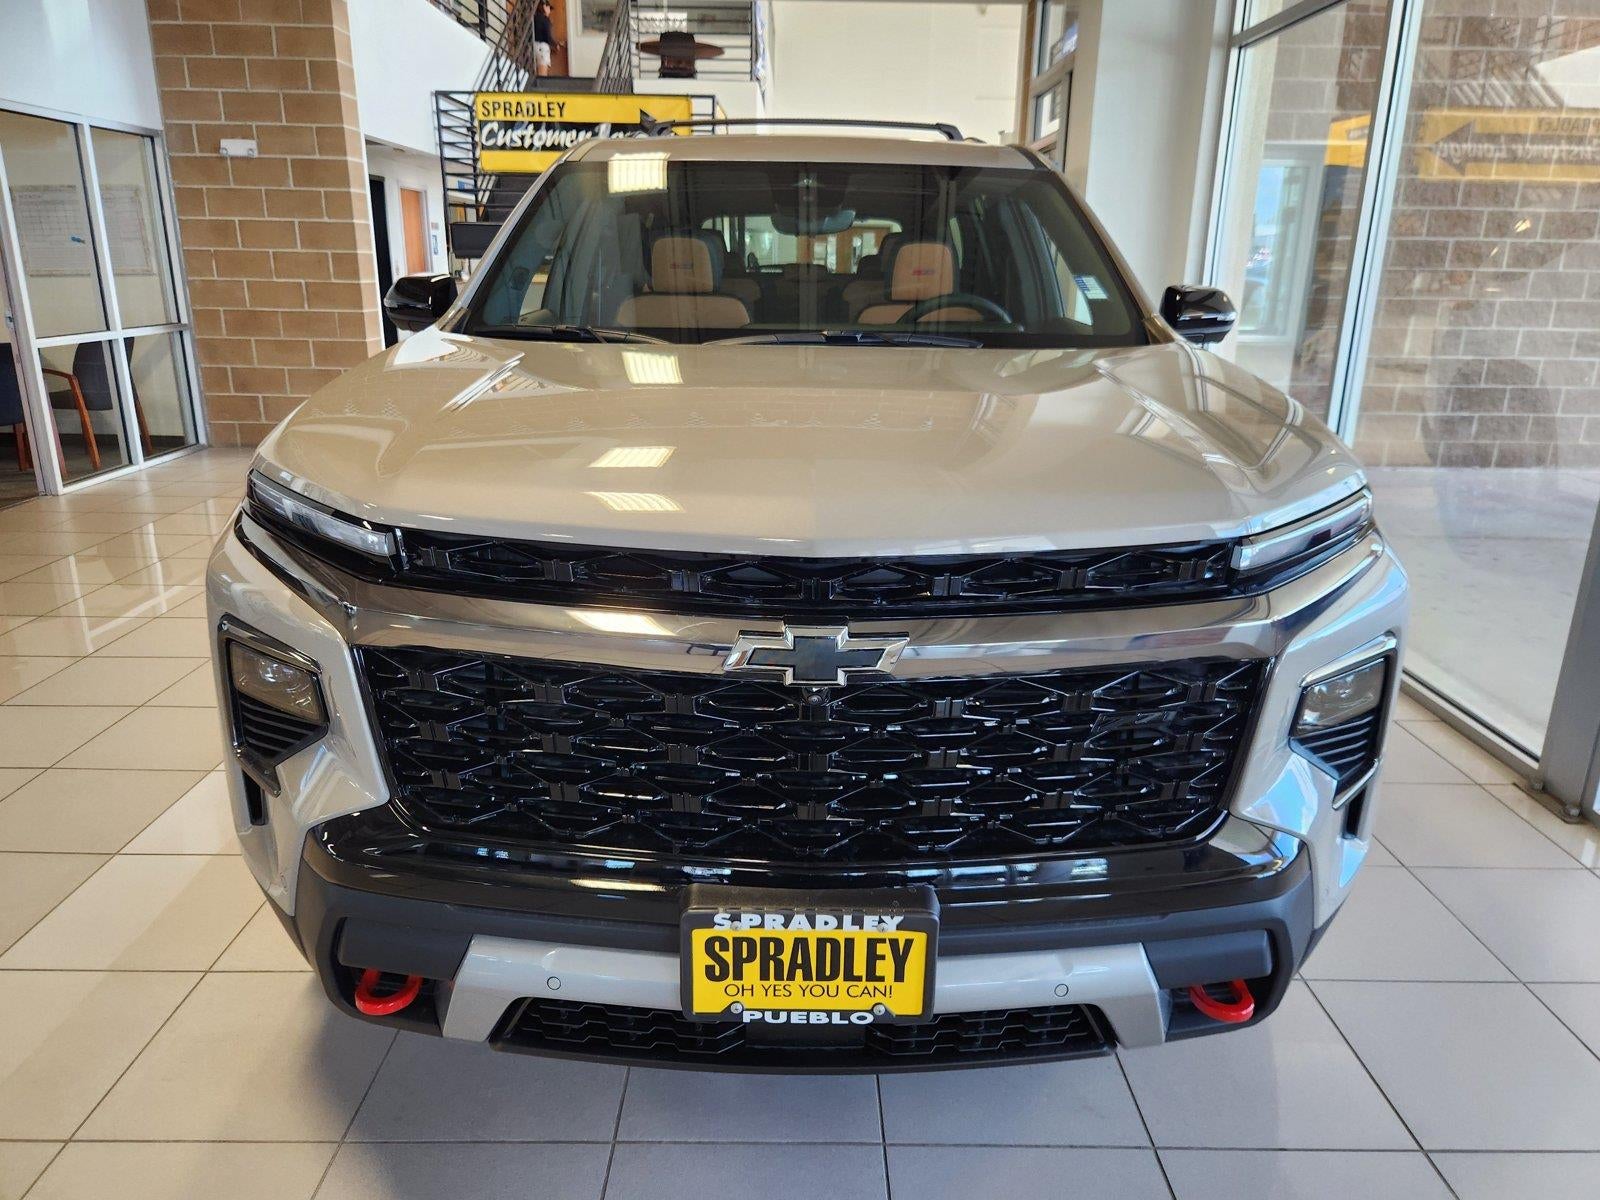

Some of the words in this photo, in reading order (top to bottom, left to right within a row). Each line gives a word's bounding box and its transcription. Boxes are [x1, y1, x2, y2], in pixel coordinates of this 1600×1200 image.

[481, 101, 566, 118] SPRADLEY
[481, 121, 592, 149] Customer
[713, 913, 904, 932] SPRADLEY
[704, 936, 914, 983] SPRADLEY
[724, 983, 754, 997] OH
[761, 984, 792, 997] YES
[798, 984, 839, 998] YOU
[846, 984, 893, 998] CAN!
[742, 1010, 875, 1024] PUEBLO
